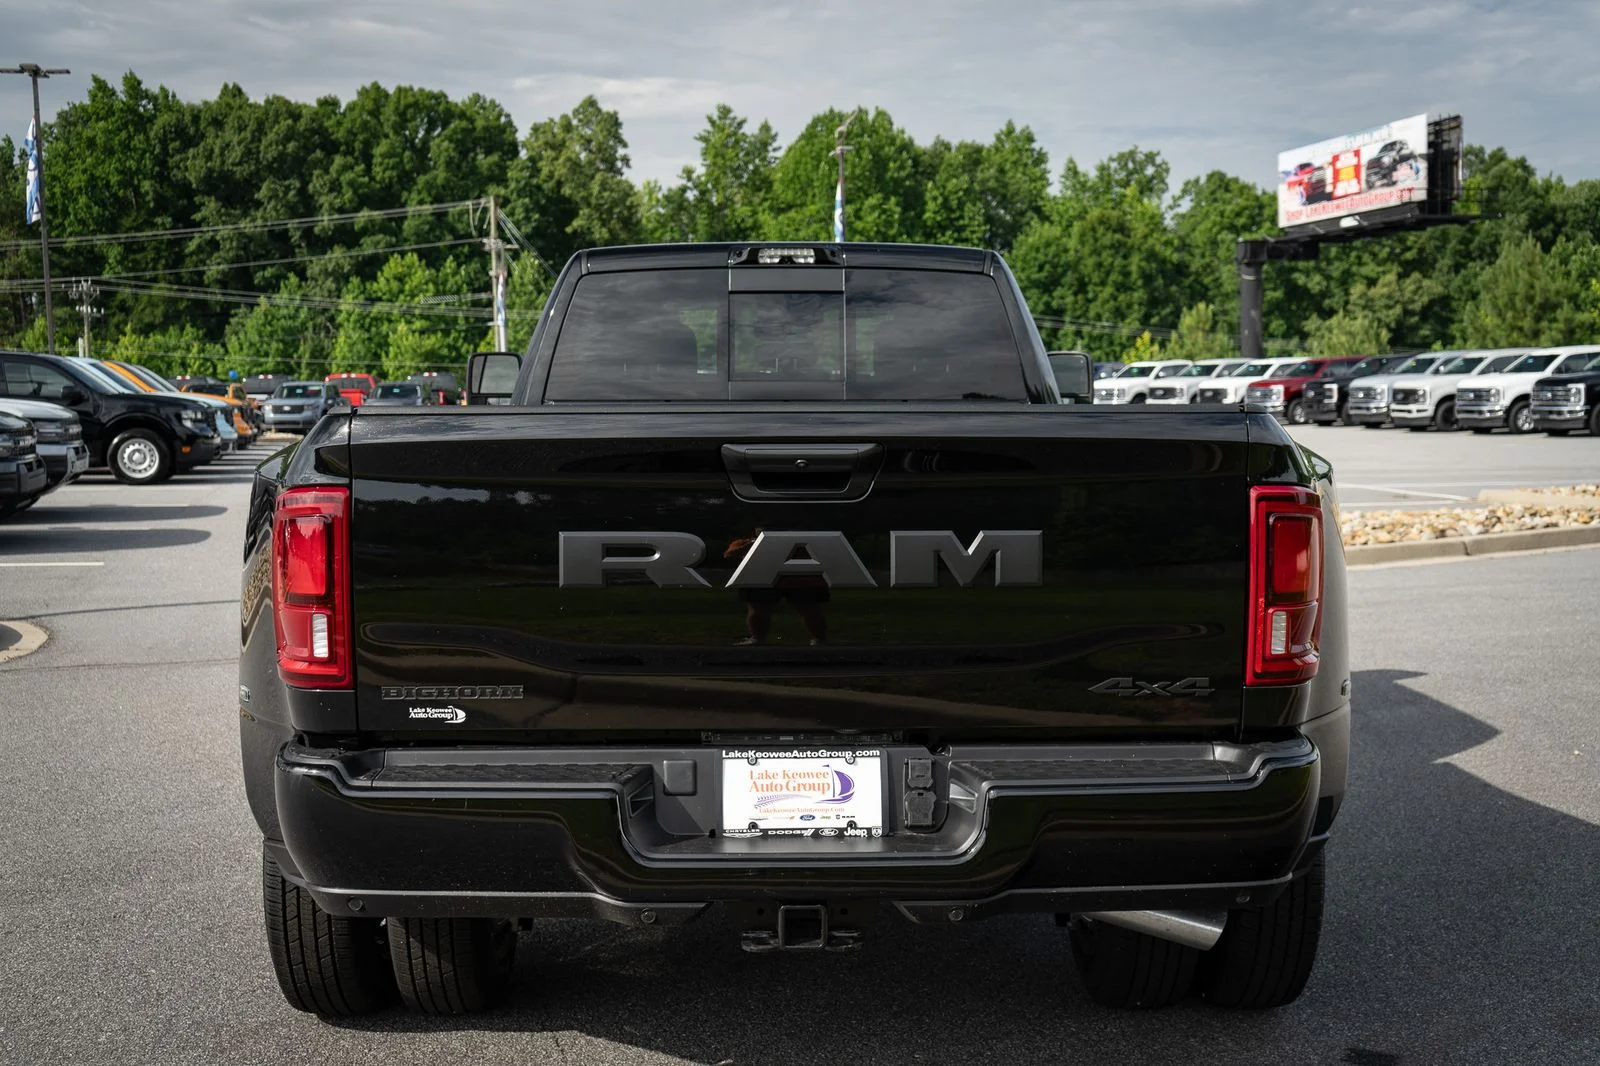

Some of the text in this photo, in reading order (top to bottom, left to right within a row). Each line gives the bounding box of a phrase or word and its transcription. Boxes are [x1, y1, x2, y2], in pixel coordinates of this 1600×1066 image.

[558, 530, 1043, 588] RAM
[381, 685, 524, 700] BIGHORN
[1088, 677, 1216, 697] 4x4
[428, 712, 453, 720] Group
[722, 749, 880, 759] LakeKeoweeAutoGroup.com
[750, 768, 830, 780] Lake Keowee
[749, 780, 831, 795] Auto Group
[844, 827, 868, 838] Jeep
